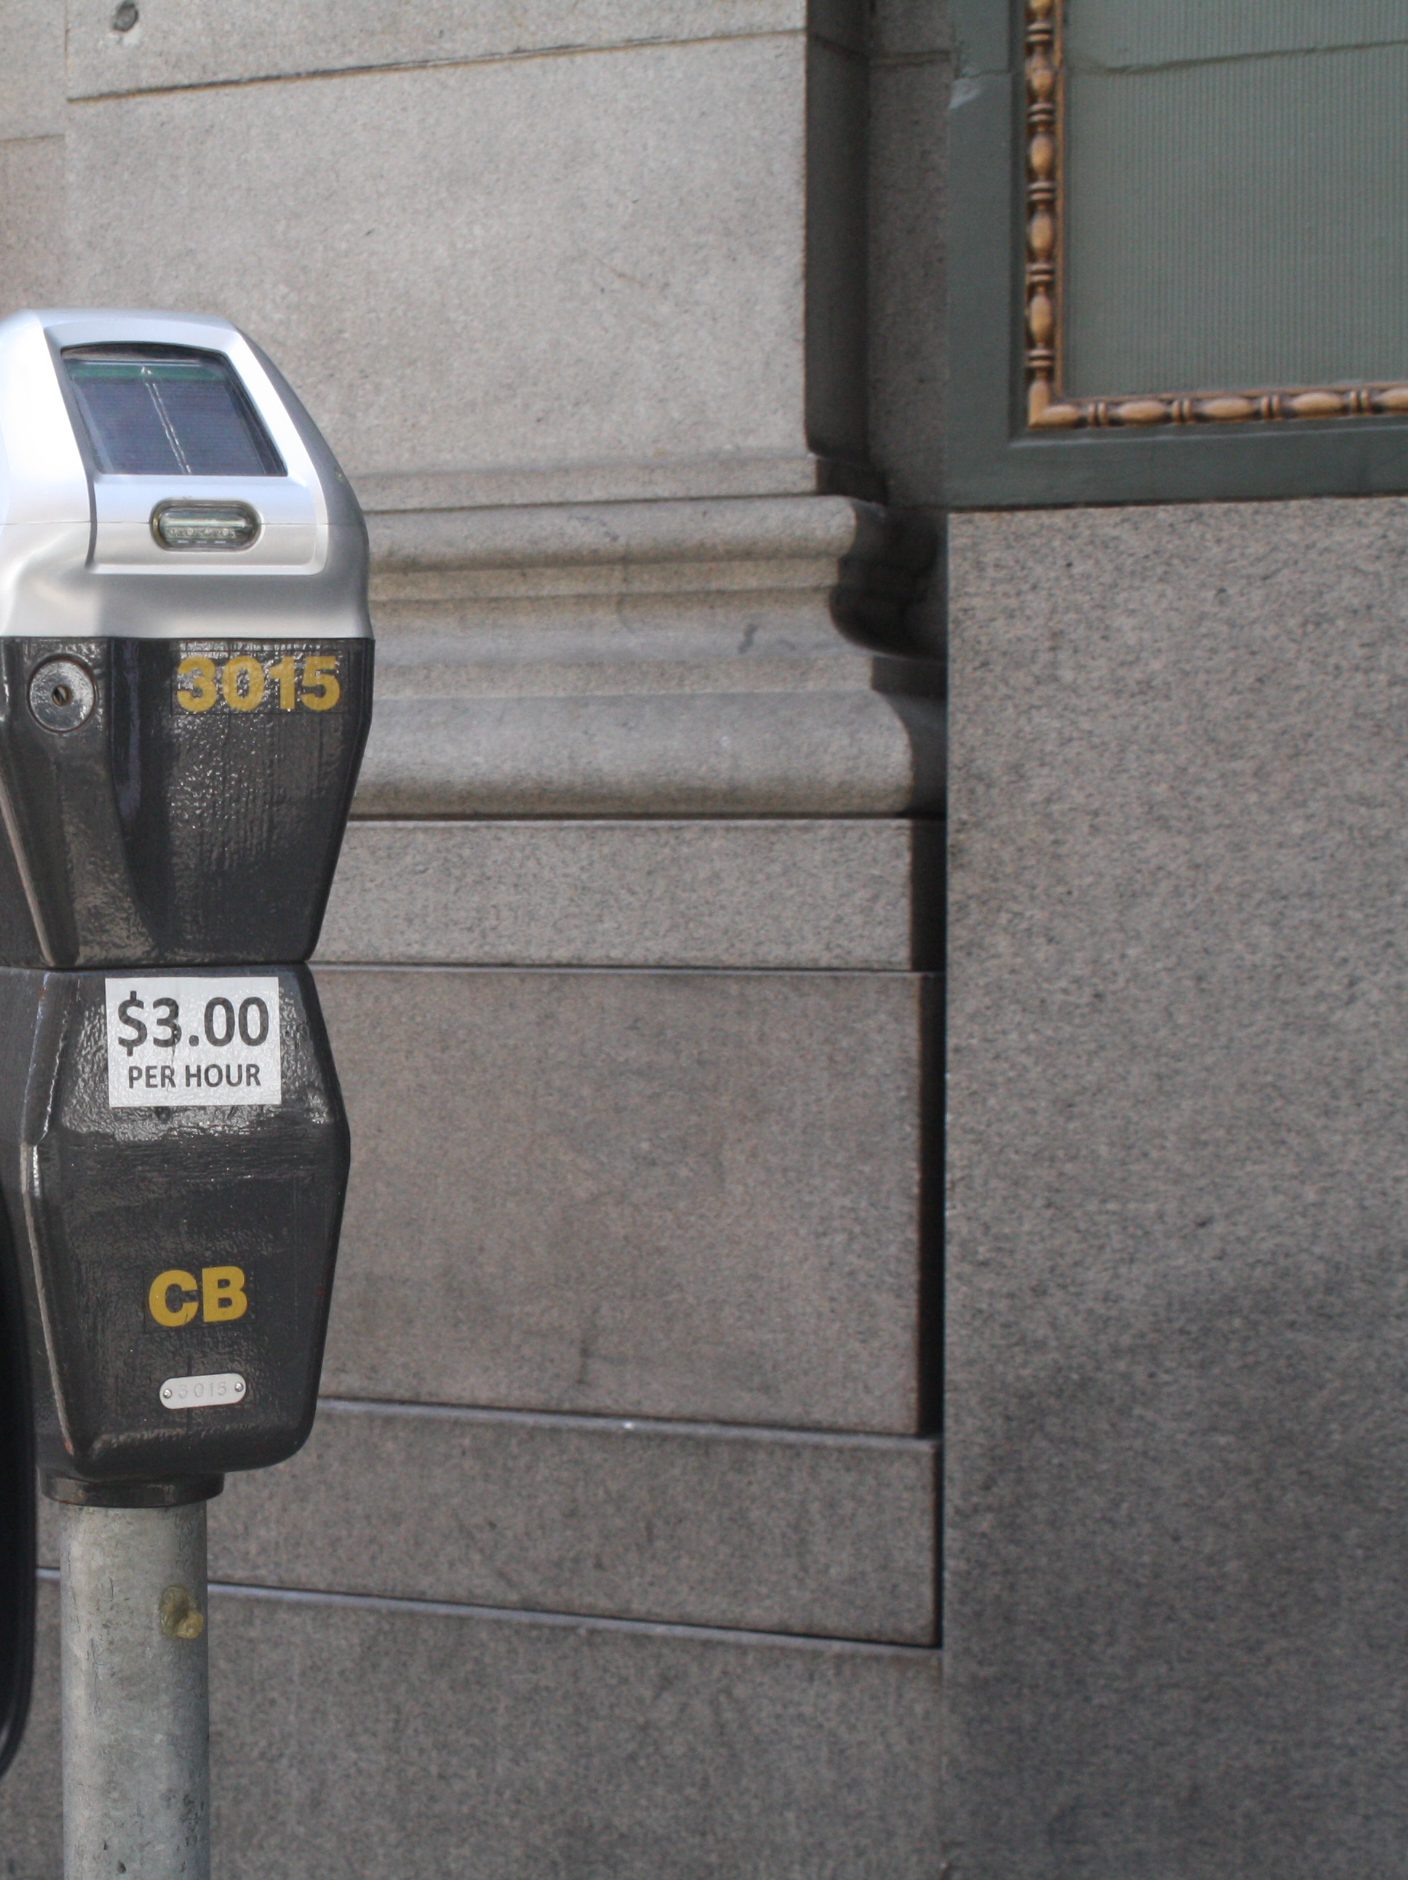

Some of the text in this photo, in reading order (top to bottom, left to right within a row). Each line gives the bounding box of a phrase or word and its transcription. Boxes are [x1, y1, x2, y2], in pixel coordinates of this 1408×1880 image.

[177, 655, 341, 713] 3015
[117, 990, 270, 1057] $3.00
[128, 1063, 261, 1089] PER HOUR
[148, 1265, 248, 1328] CB
